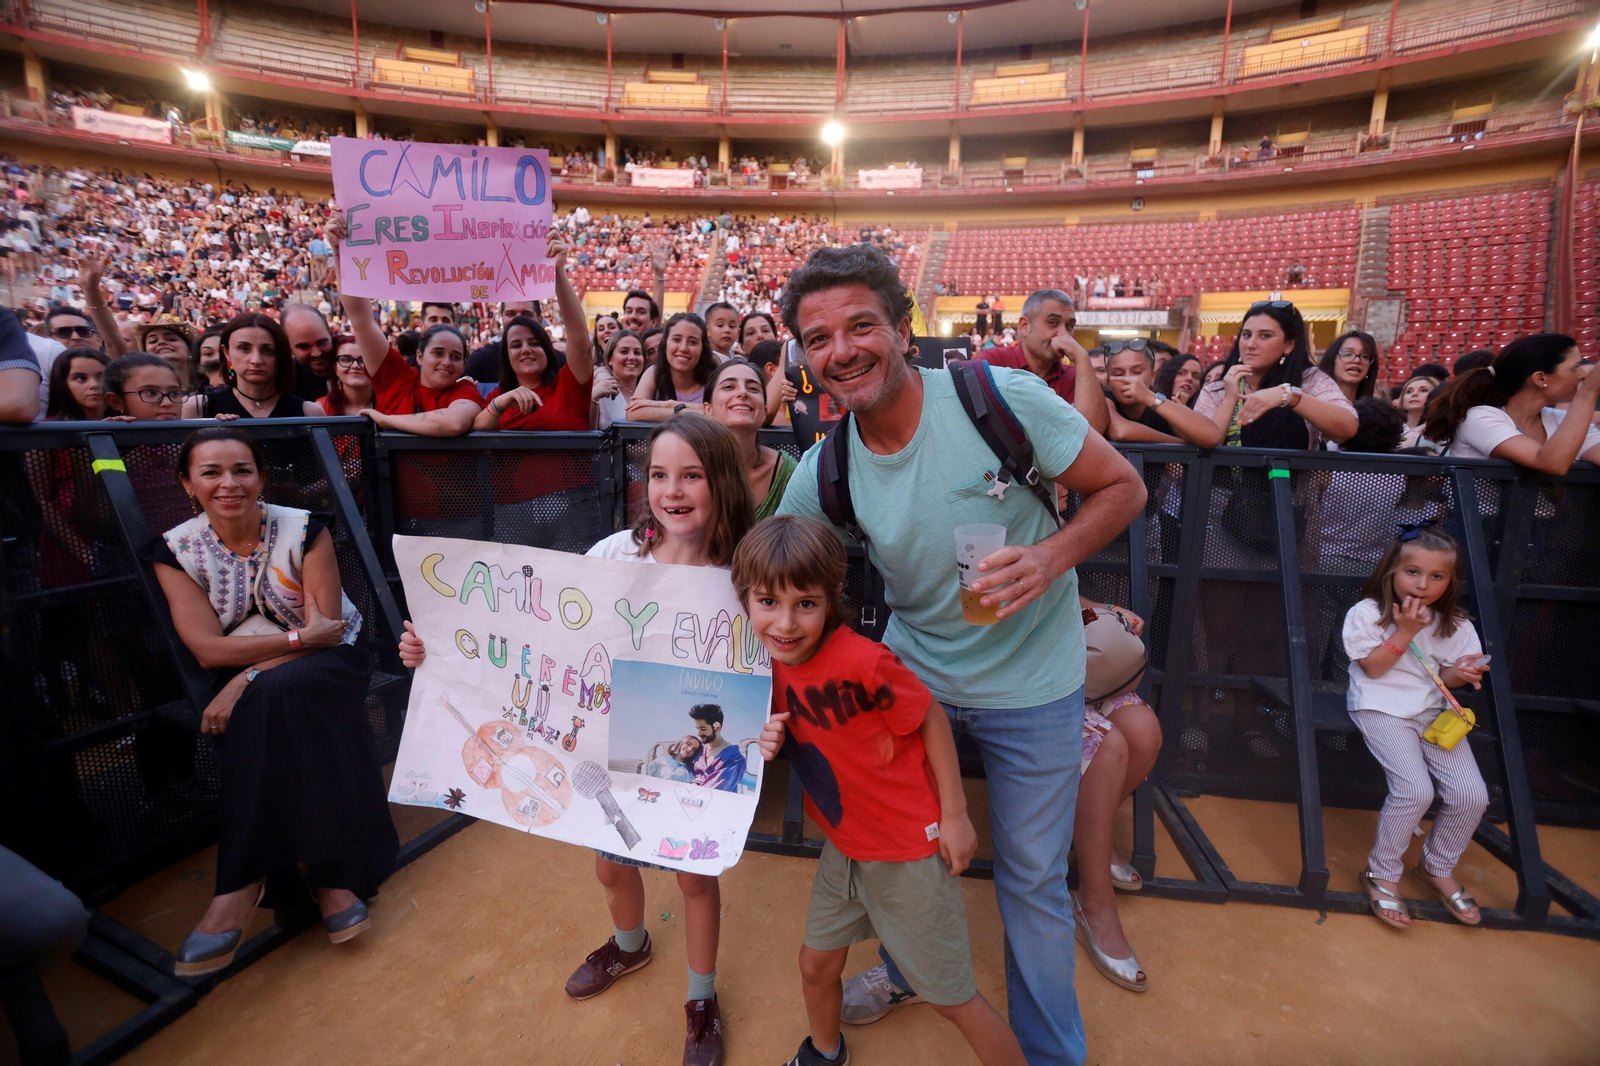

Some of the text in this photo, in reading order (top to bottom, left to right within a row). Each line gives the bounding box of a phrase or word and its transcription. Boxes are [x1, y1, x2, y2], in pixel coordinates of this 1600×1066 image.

[346, 203, 429, 247] ERES
[352, 257, 371, 280] Y
[386, 250, 494, 285] REVOLUCIÓN
[471, 285, 489, 299] DE
[420, 552, 592, 630] CAMILO
[615, 598, 658, 650] Y
[511, 673, 550, 721] UN
[785, 679, 896, 730] AMILO
